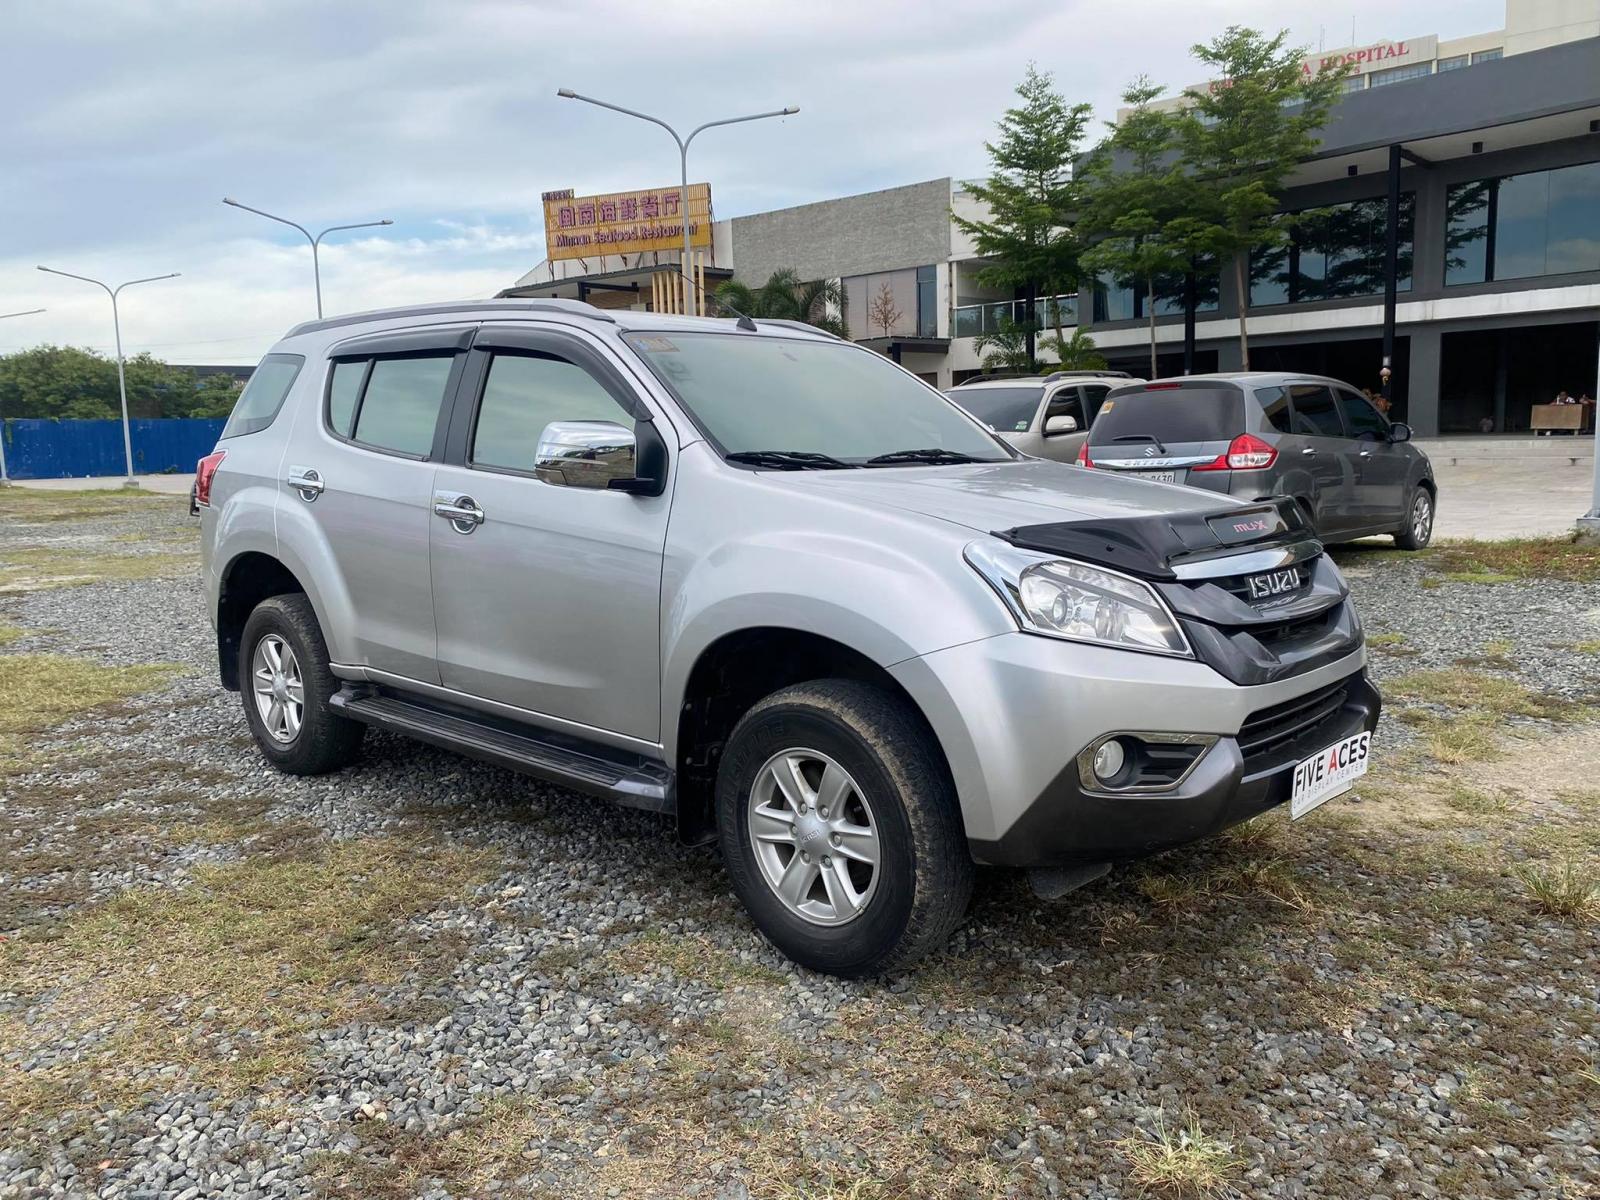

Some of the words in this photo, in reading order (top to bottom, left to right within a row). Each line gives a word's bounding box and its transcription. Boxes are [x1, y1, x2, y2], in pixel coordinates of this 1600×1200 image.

[594, 227, 638, 244] Seafood
[1249, 568, 1300, 598] ISUZU
[1294, 755, 1324, 798] FIVE
[1328, 735, 1368, 775] ACES
